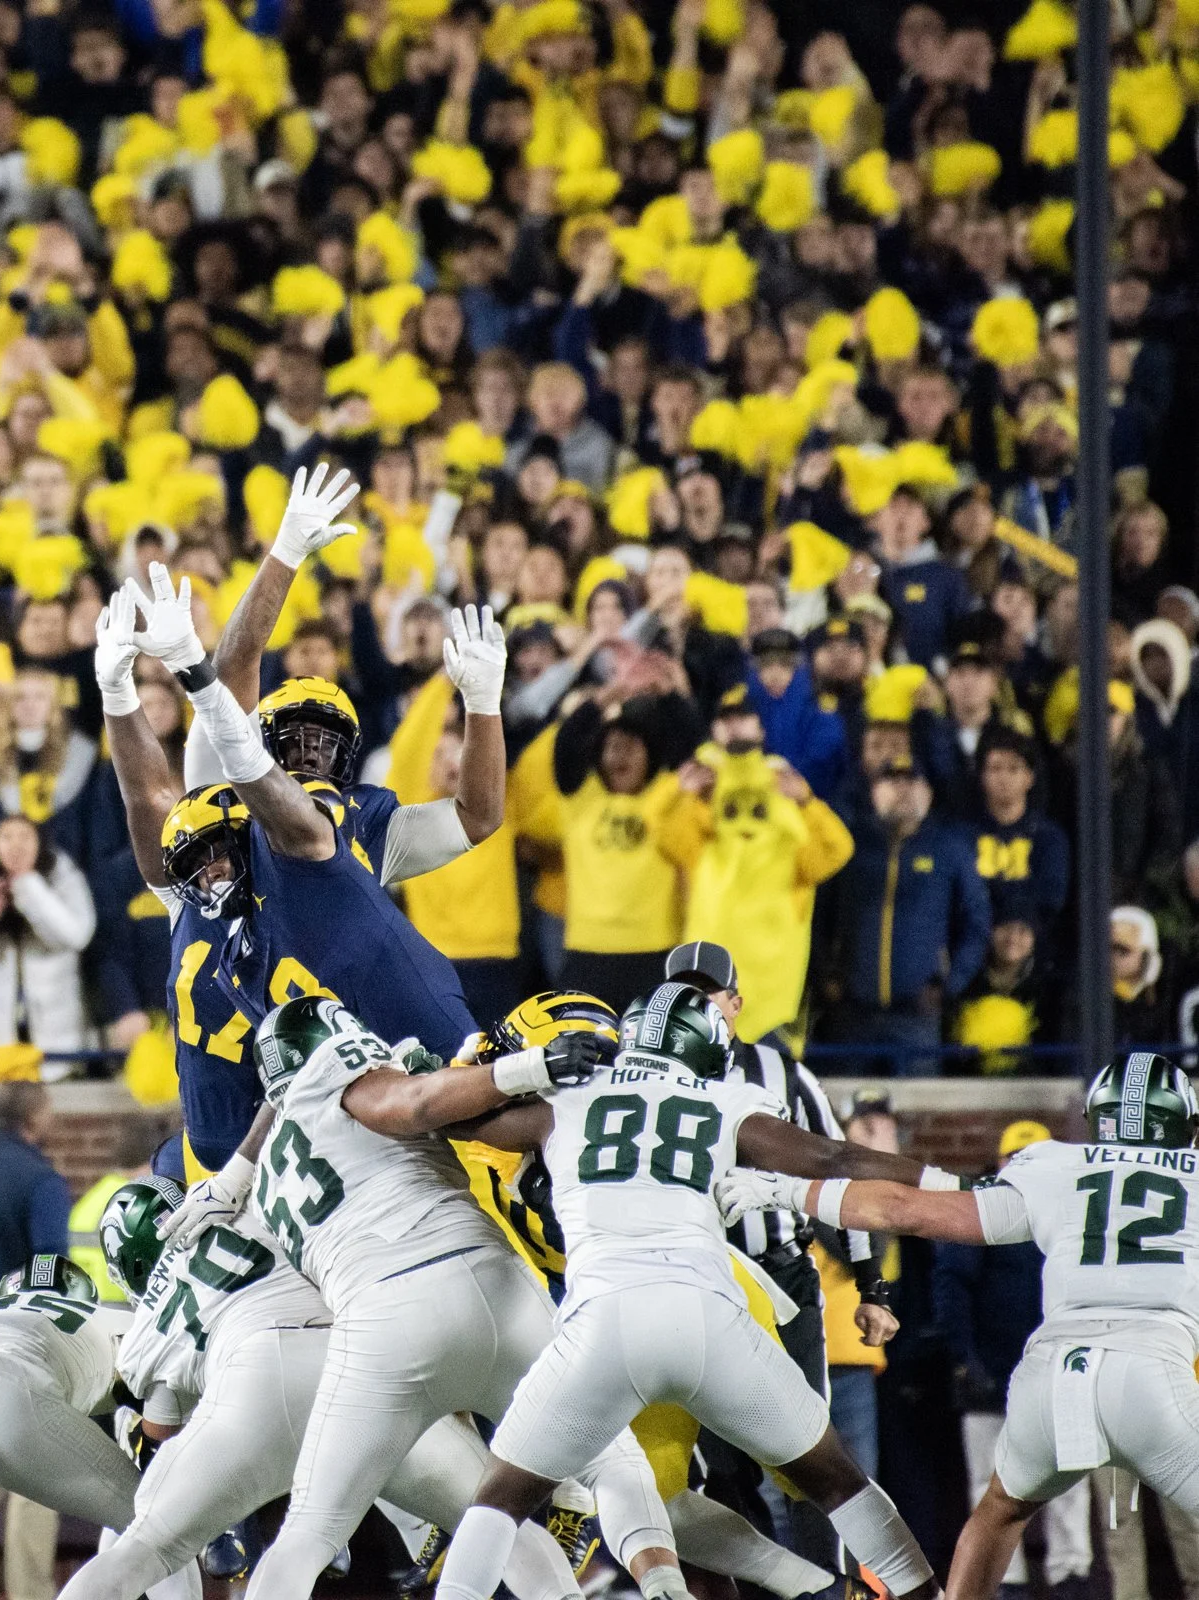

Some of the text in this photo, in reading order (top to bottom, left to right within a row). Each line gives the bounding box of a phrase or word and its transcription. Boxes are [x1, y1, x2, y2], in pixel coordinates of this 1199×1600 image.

[334, 1038, 393, 1071] 53
[625, 1056, 670, 1073] SPARTANS
[578, 1093, 723, 1195] 88
[1084, 1146, 1197, 1174] VELLING
[257, 1119, 346, 1273] 53
[1076, 1170, 1189, 1266] 12
[156, 1224, 276, 1352] 70
